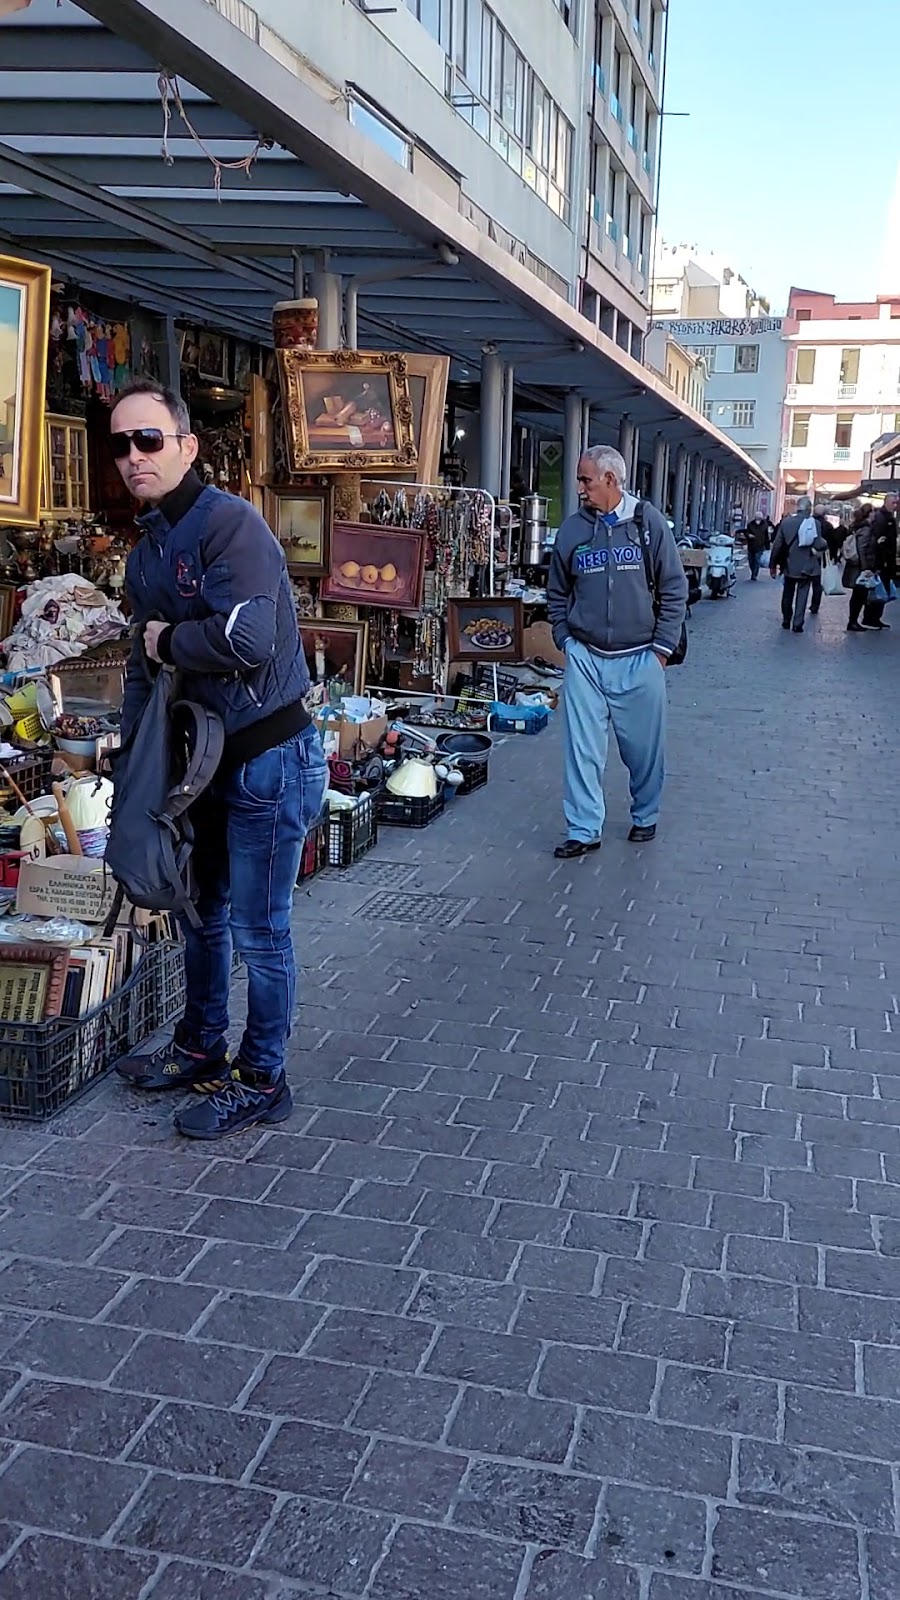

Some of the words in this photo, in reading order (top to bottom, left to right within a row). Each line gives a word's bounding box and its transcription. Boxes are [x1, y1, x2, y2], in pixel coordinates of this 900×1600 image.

[576, 549, 609, 570] NEED
[612, 546, 643, 563] YOU
[63, 873, 97, 882] ΕΚΛΕΚΤΑ
[48, 880, 85, 890] ΕΛΛΗΝΙΚΑ
[86, 883, 112, 892] ΚΡΑΑ
